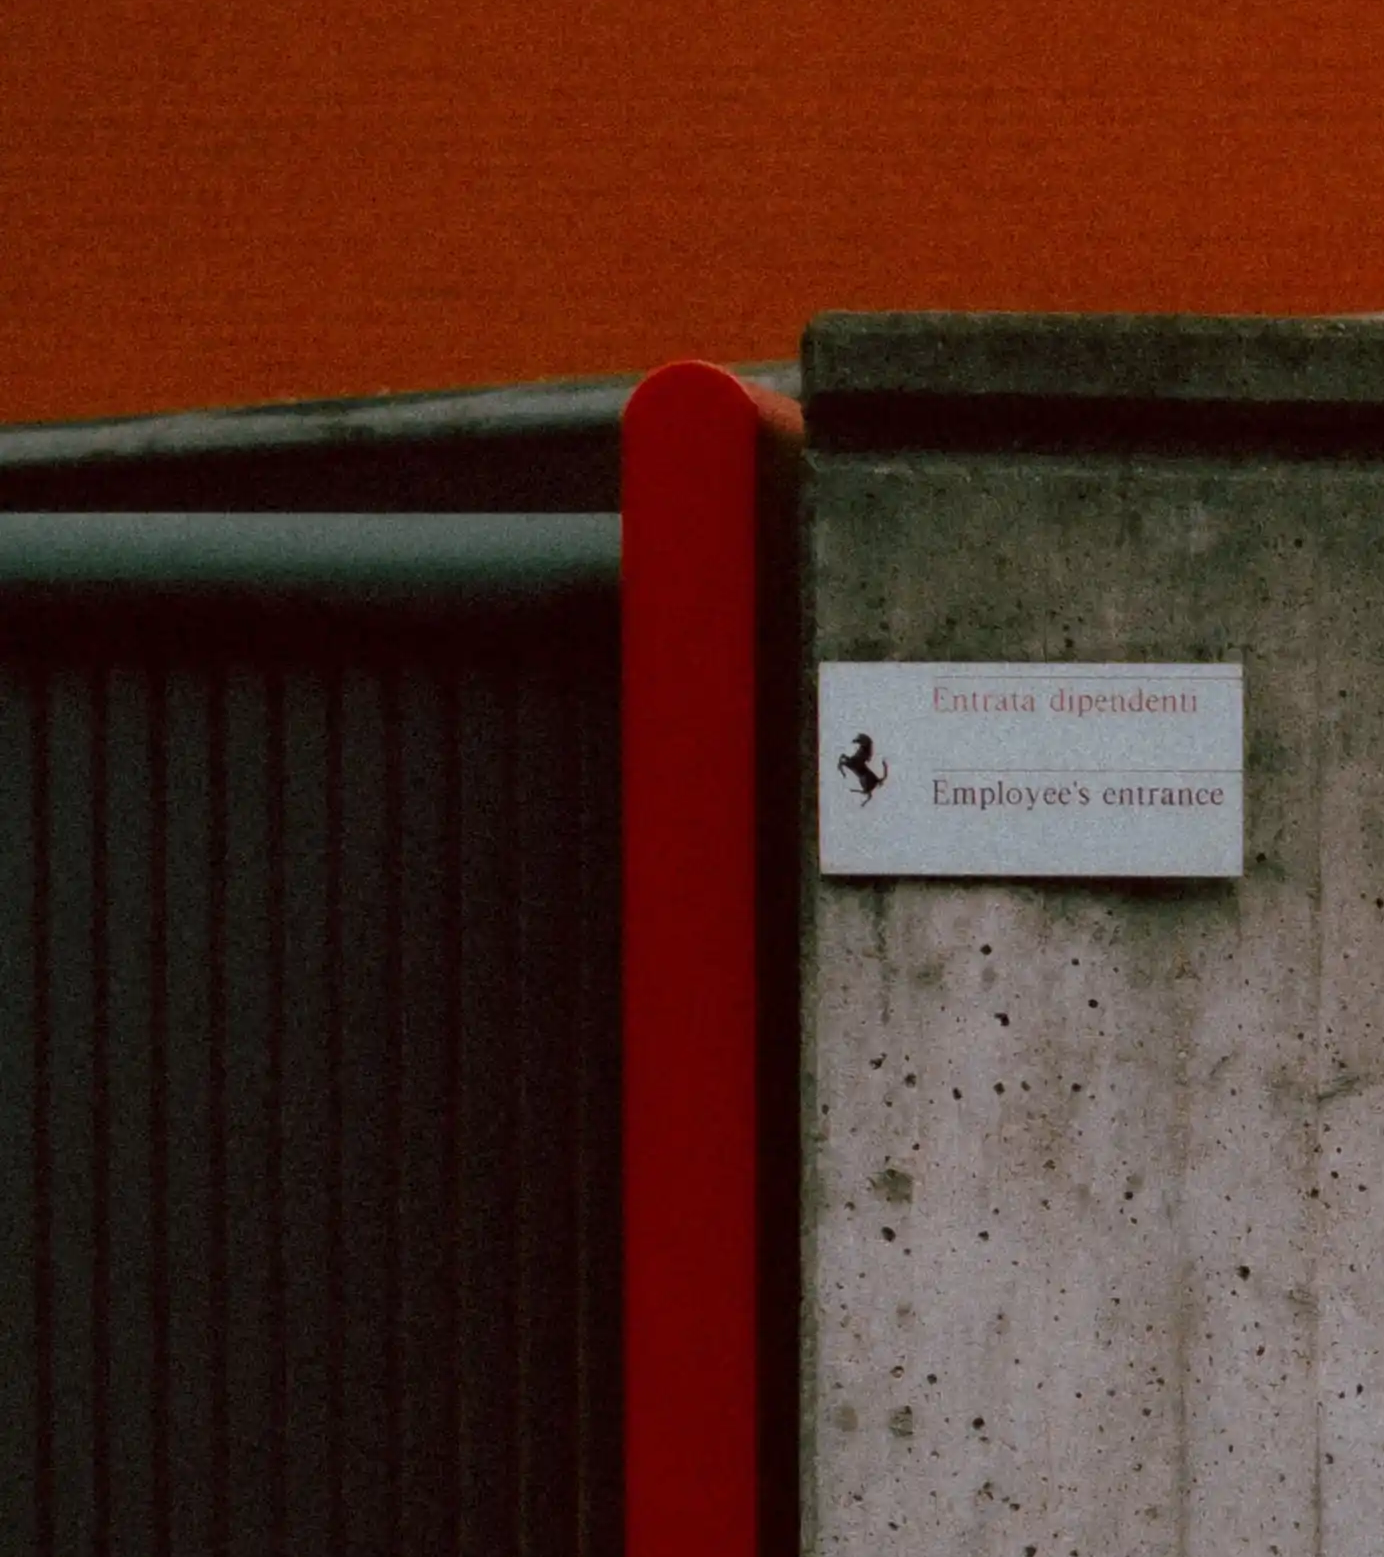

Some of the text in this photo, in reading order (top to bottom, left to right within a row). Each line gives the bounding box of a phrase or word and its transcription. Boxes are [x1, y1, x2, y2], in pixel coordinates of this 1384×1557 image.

[932, 686, 1199, 718] Entrata dipendenti
[931, 778, 1225, 811] Employee's entrance
